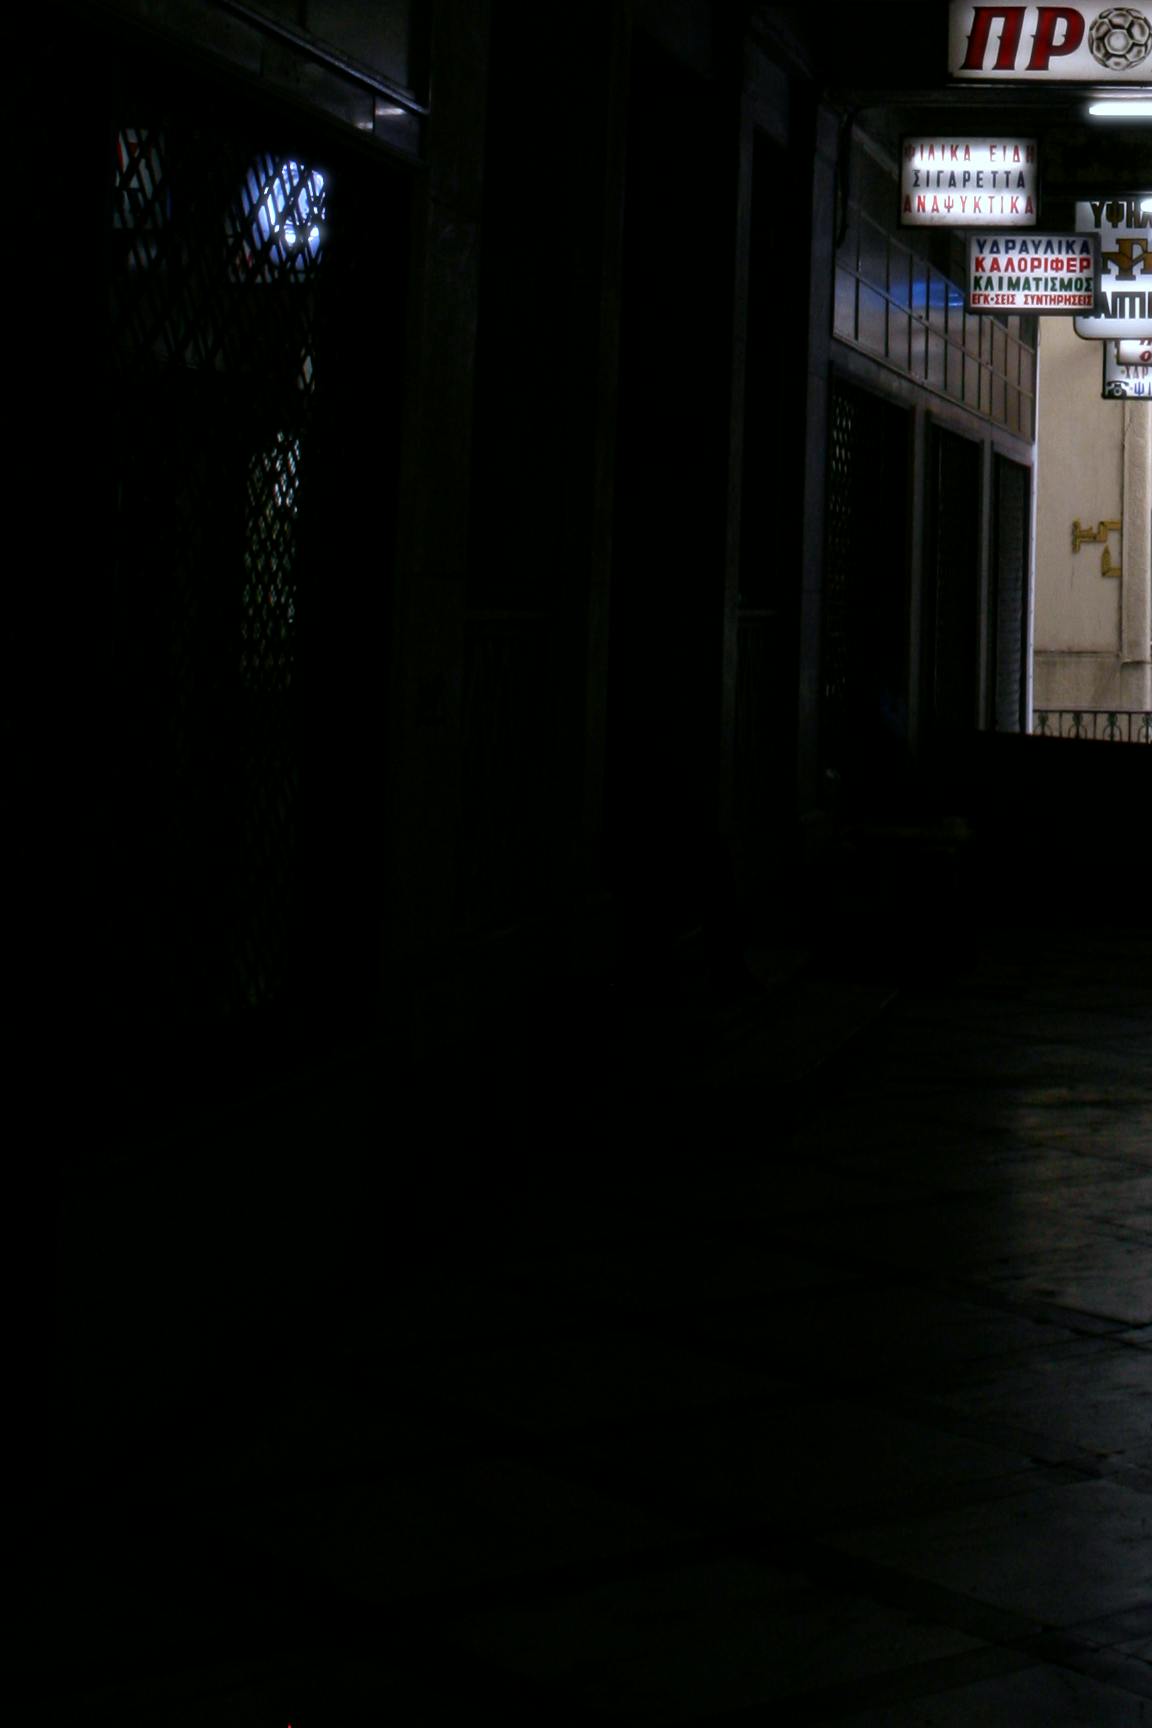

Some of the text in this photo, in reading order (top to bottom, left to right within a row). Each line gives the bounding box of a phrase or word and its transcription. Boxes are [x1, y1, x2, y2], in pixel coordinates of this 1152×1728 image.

[989, 144, 1036, 163] ΕΙΔΗ
[912, 170, 1026, 189] ΣΙΓΑΡΕΤΤΑ
[903, 194, 1035, 215] ΑΝΑΨΥΚΤΙΚΑ
[976, 239, 1091, 255] ΥΔΡΑΥΛΙΚΑ
[974, 256, 1091, 273] ΚΑΛΟΡΙΦΕΡ
[973, 276, 1093, 292] ΚΛΙΜΑΤΙΣΜΟΣ
[1023, 294, 1092, 306] ΣΥΝΤΗΡΗΣΕΙΣ
